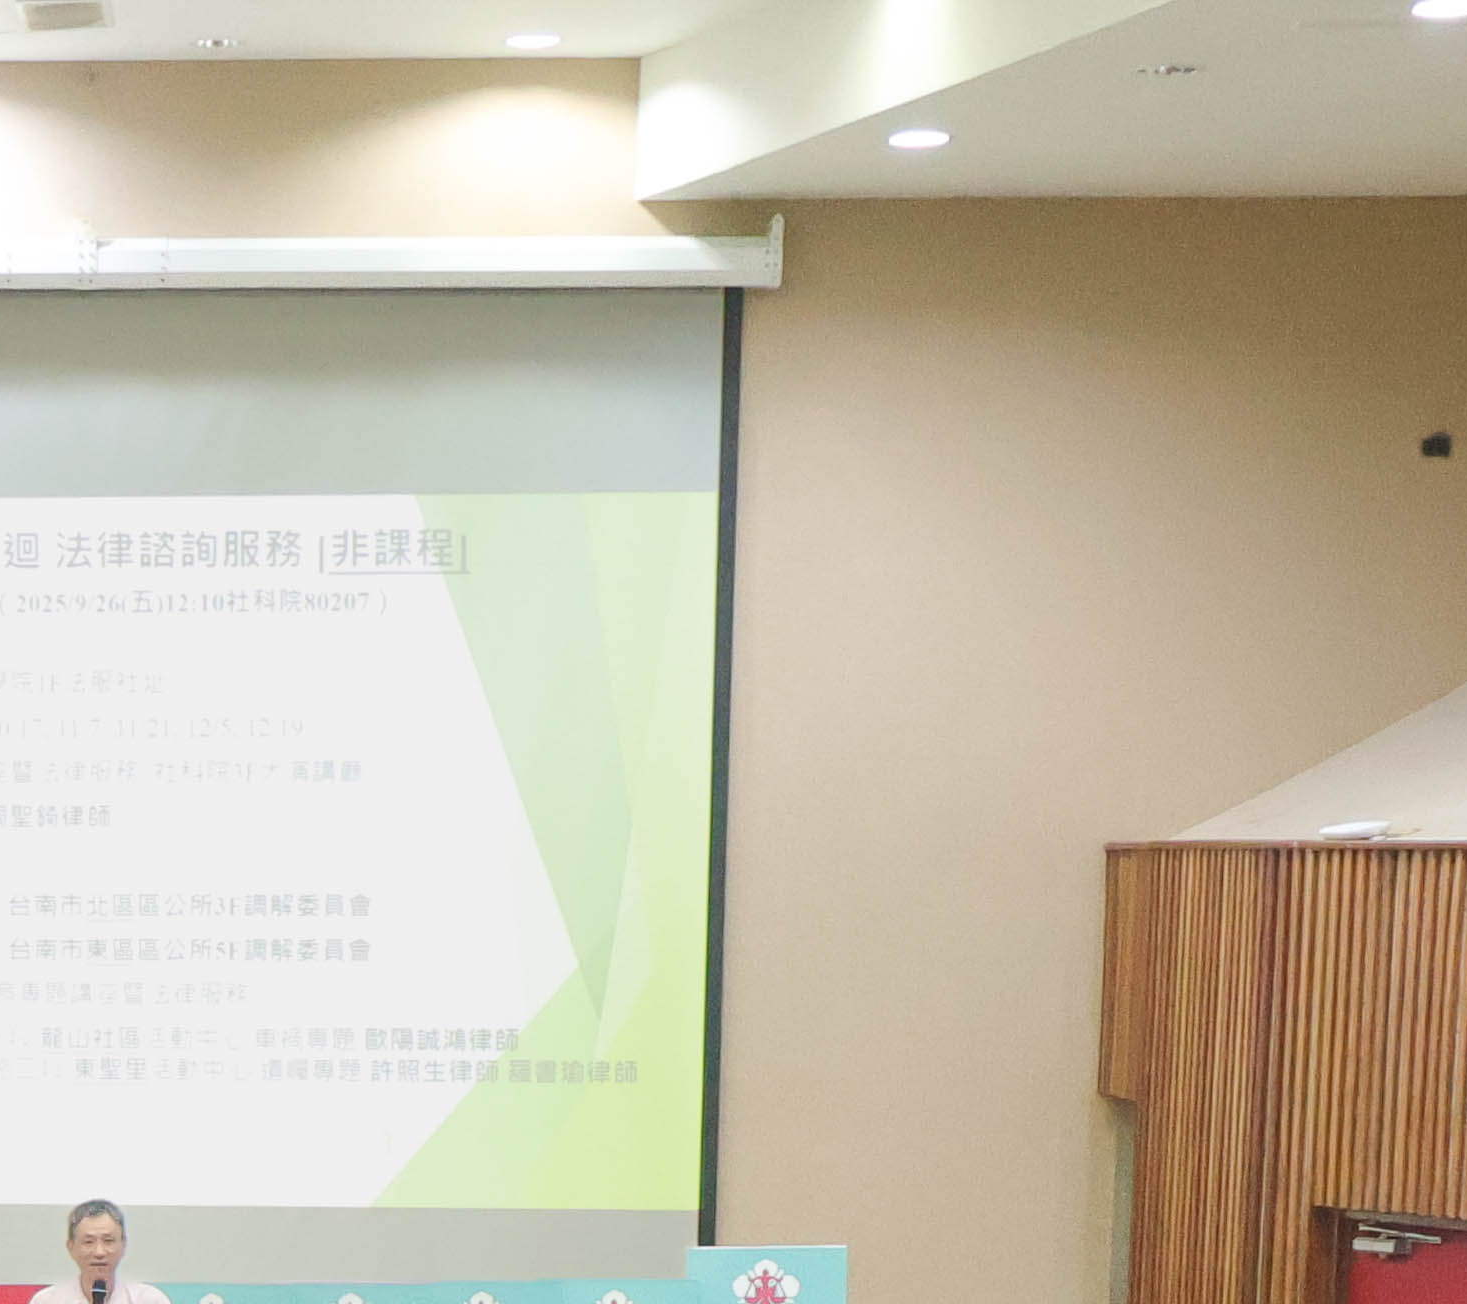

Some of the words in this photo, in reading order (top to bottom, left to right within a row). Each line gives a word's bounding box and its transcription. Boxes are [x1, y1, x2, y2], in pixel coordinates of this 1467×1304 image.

[56, 529, 302, 570] 法律諮詢服務
